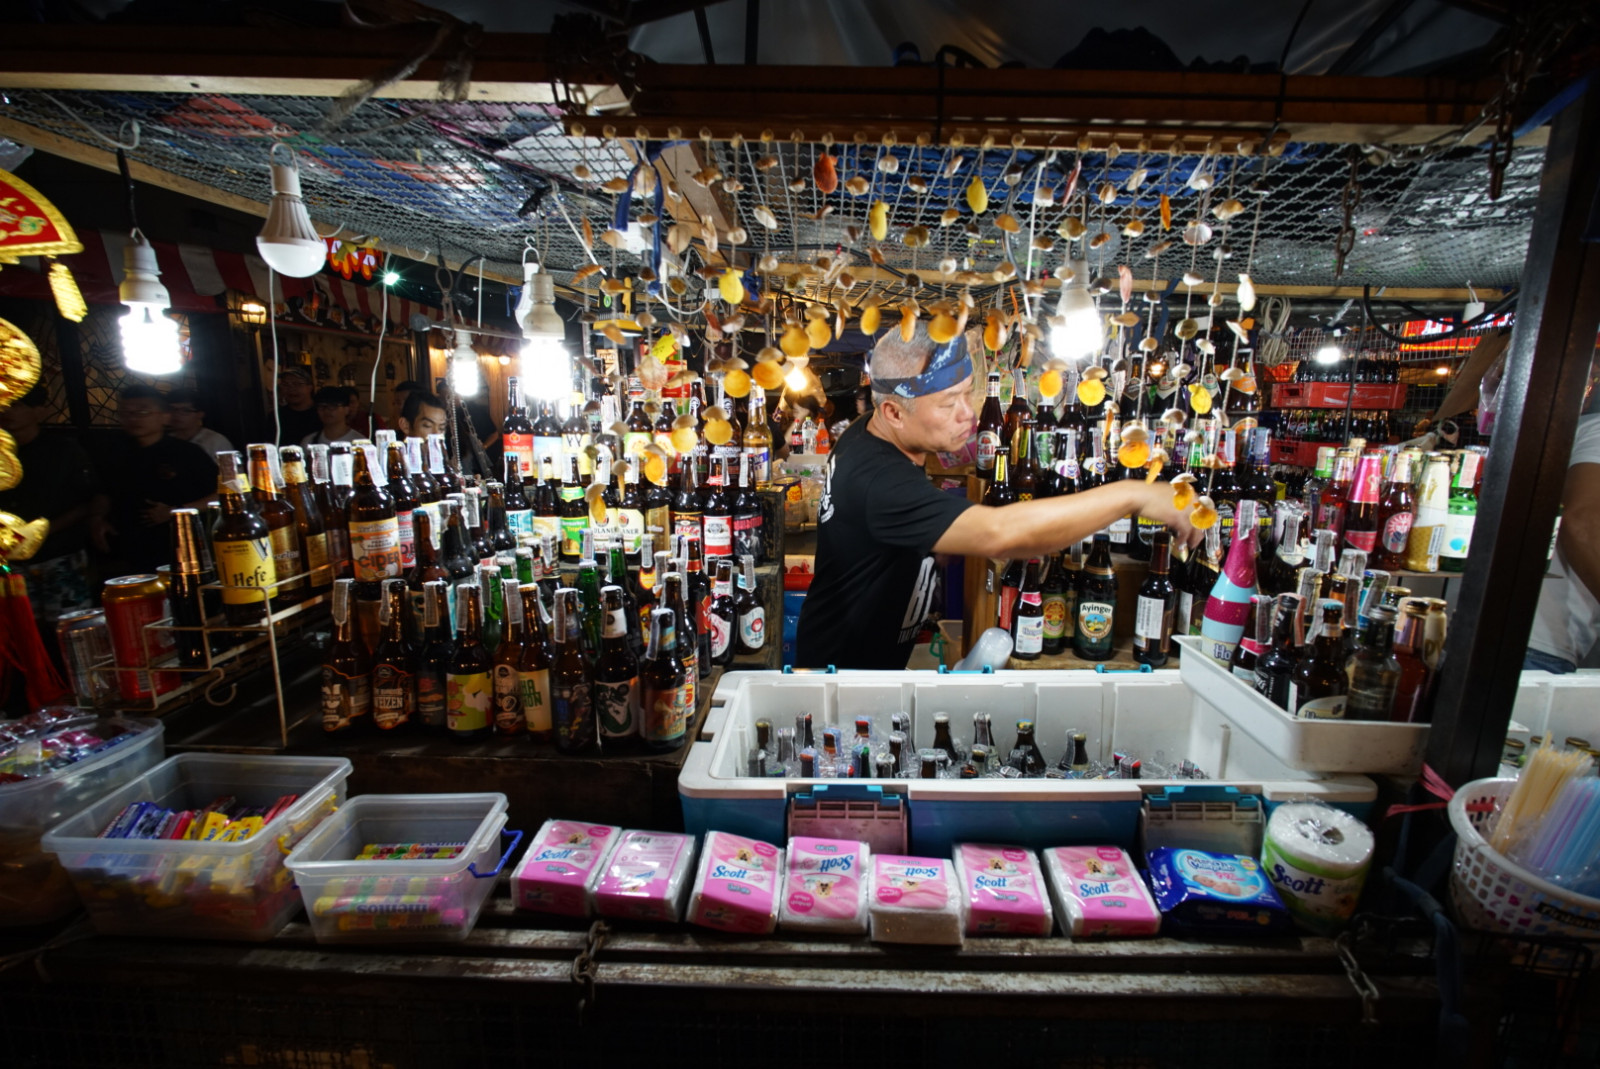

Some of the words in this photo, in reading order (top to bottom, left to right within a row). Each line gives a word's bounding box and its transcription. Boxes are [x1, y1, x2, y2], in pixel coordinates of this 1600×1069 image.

[358, 551, 399, 571] CIDER
[233, 565, 267, 589] Hefe
[1082, 604, 1112, 614] Ayinger
[1213, 643, 1232, 660] Ho
[535, 849, 572, 861] Scott
[820, 855, 854, 872] Scott
[712, 865, 747, 879] Scott
[905, 867, 938, 877] Scott
[1273, 863, 1325, 895] Scott
[974, 875, 1008, 889] Scott
[1080, 882, 1110, 897] Scott
[356, 903, 428, 914] mentos
